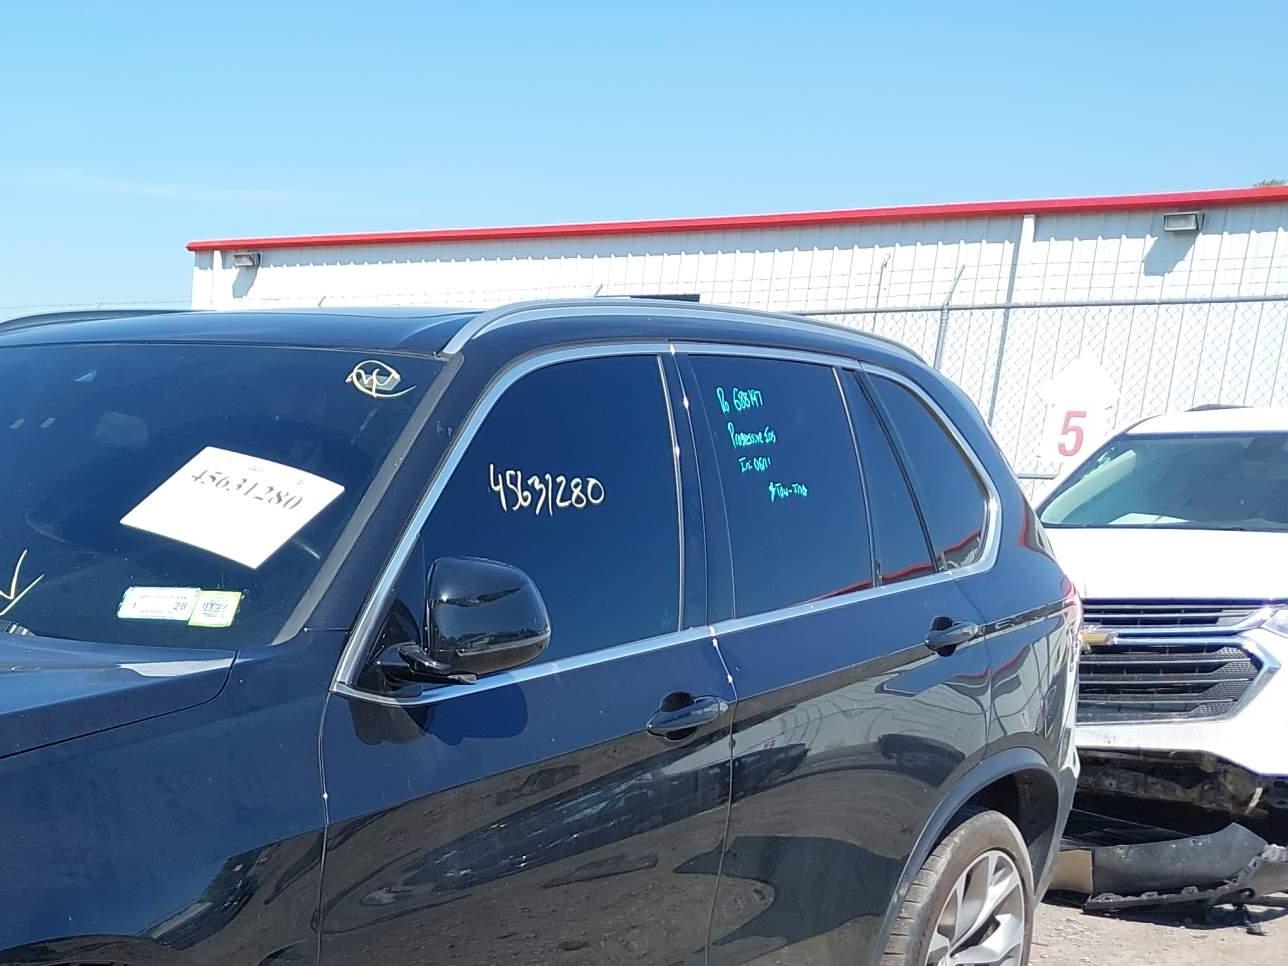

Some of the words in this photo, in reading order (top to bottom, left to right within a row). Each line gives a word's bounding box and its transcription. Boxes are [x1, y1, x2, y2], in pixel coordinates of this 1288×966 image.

[1057, 410, 1088, 457] 5
[191, 468, 304, 510] 45631280
[489, 463, 605, 517] 45631280
